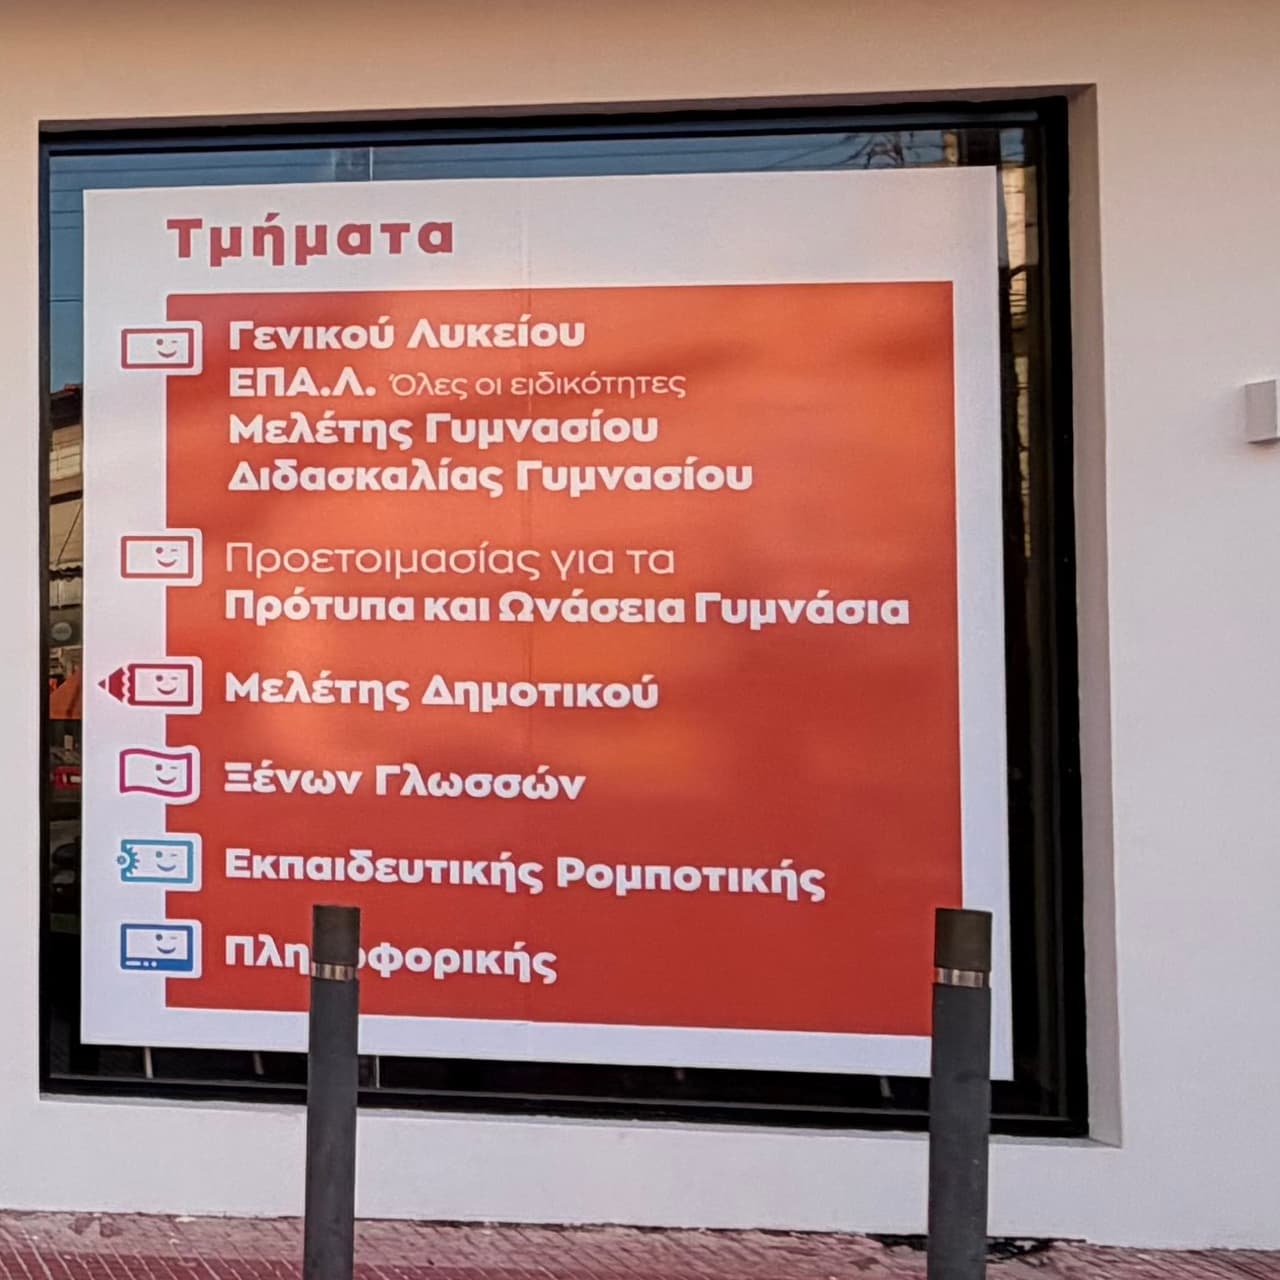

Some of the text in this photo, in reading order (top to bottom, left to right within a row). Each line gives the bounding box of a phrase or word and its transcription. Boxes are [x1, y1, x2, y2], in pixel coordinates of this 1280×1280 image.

[166, 212, 453, 267] Τμήματα
[229, 314, 586, 351] Γενικού Λυκείου
[229, 367, 687, 400] ΕΠΑ.Λ. Όλες οι ειδικότητες
[228, 408, 659, 451] Μελέτης Γυμνασίου
[227, 456, 754, 498] Διδασκαλίας Γυμνασίου
[226, 540, 676, 581] Προετοιμασίας για τα
[225, 586, 910, 631] Πρότυπα και Ωνάσεια Γυμνάσια
[225, 670, 658, 713] Μελέτης Δημοτικού
[224, 759, 586, 801] Ξένων Γλωσσών
[225, 847, 826, 902] Εκπαιδευτικής Ρομποτικής
[225, 933, 557, 985] Πληφορικής
